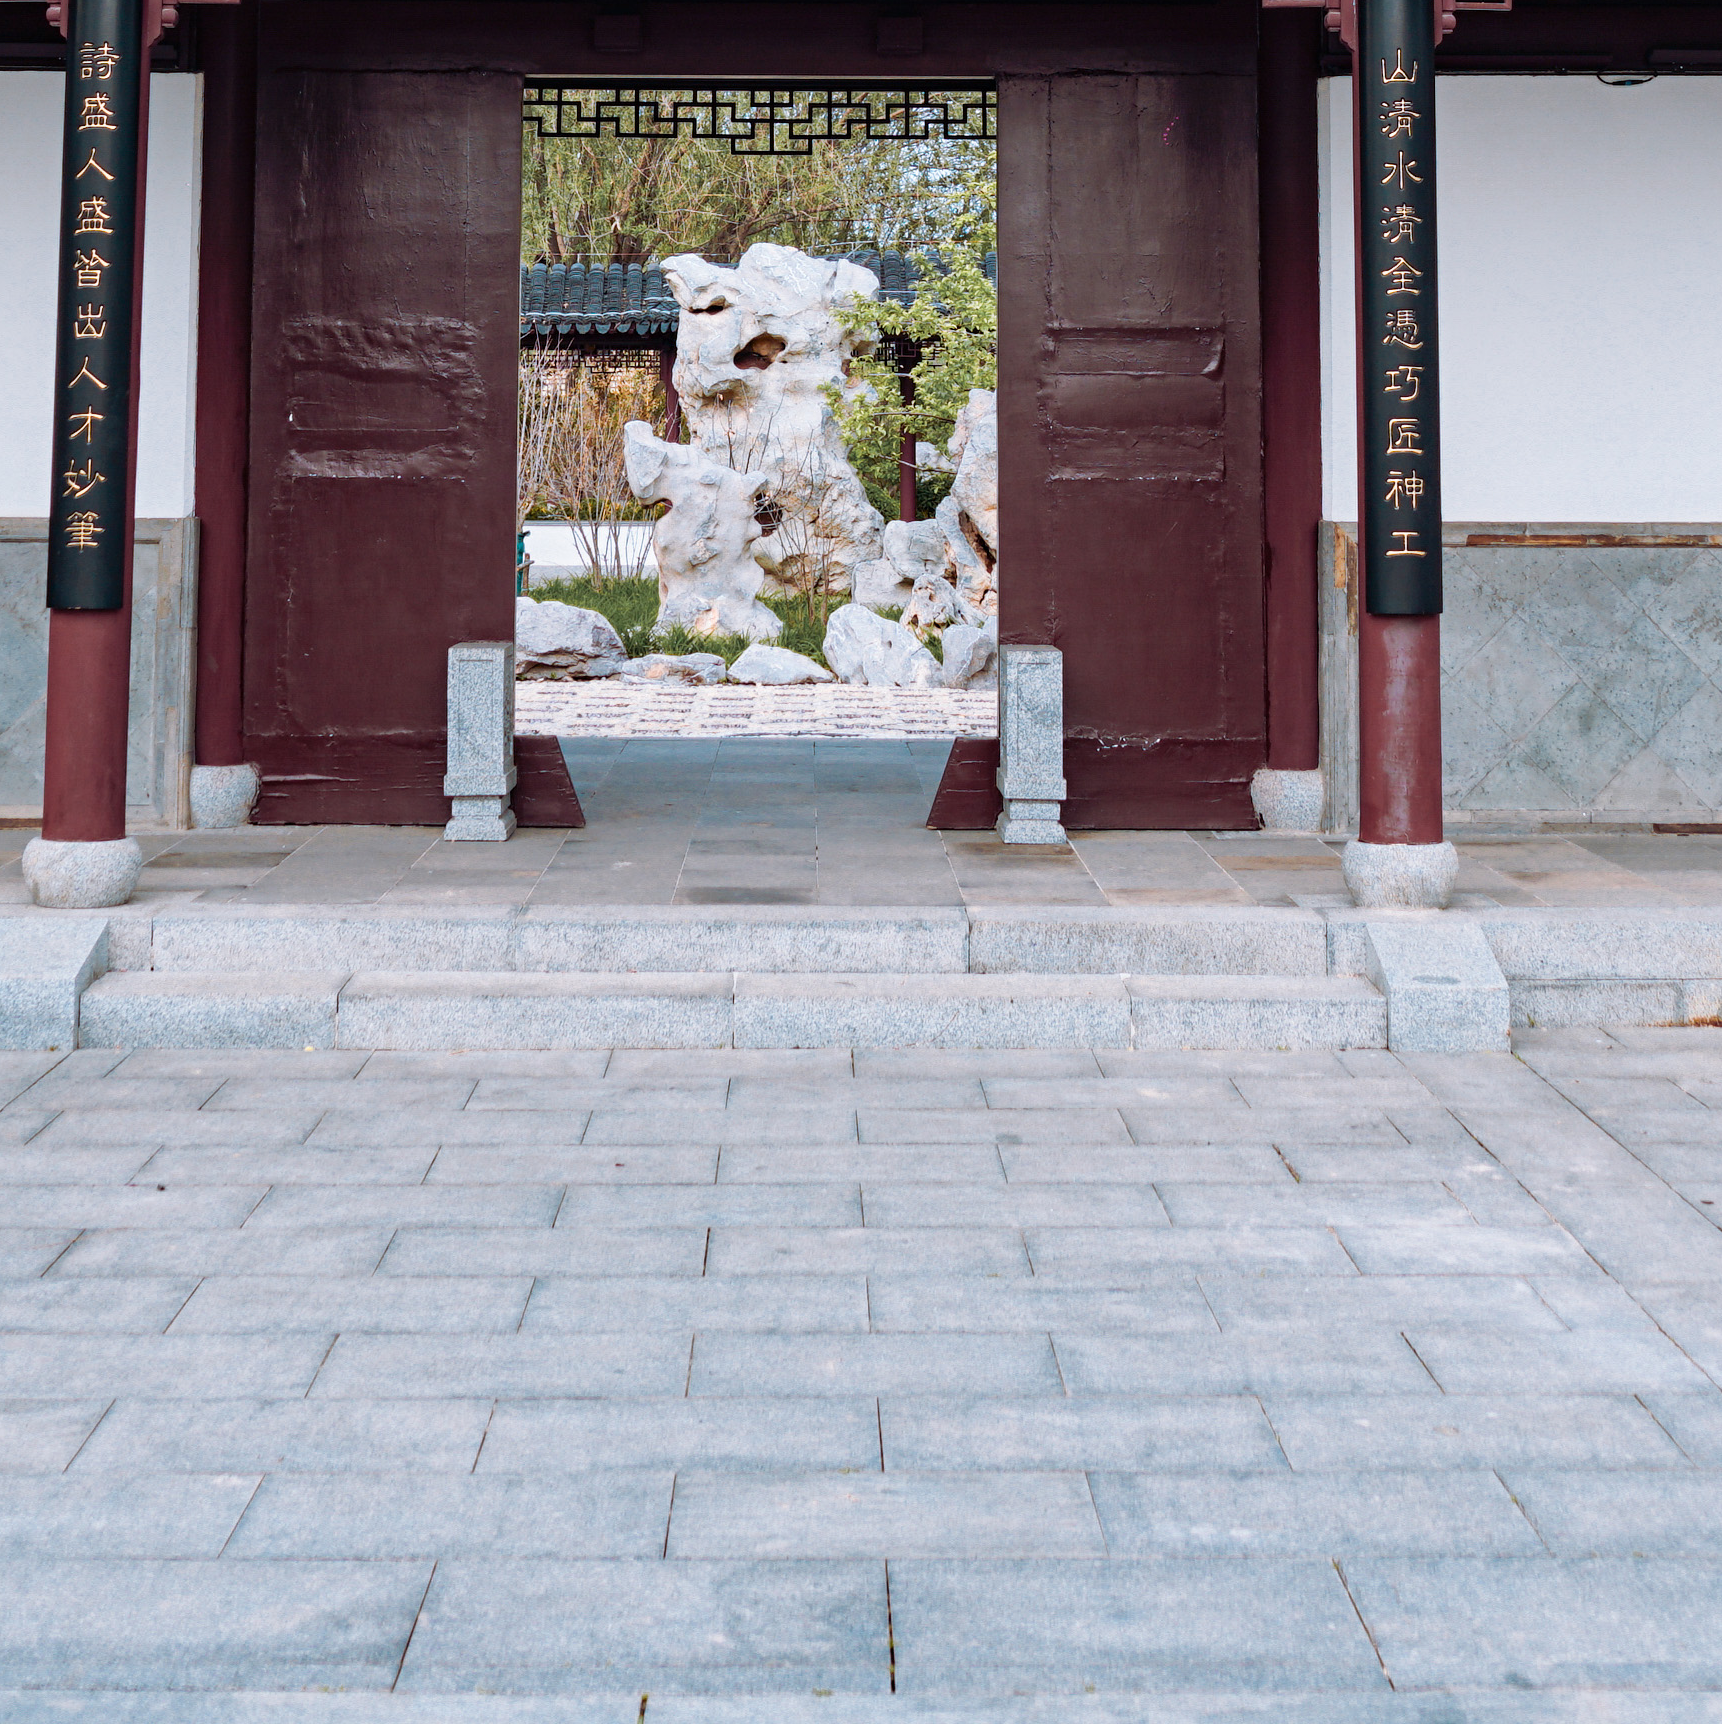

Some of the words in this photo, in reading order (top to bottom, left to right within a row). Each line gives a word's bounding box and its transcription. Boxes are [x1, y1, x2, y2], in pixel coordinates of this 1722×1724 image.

[1378, 47, 1428, 558] 山清水清全憑巧匠神工
